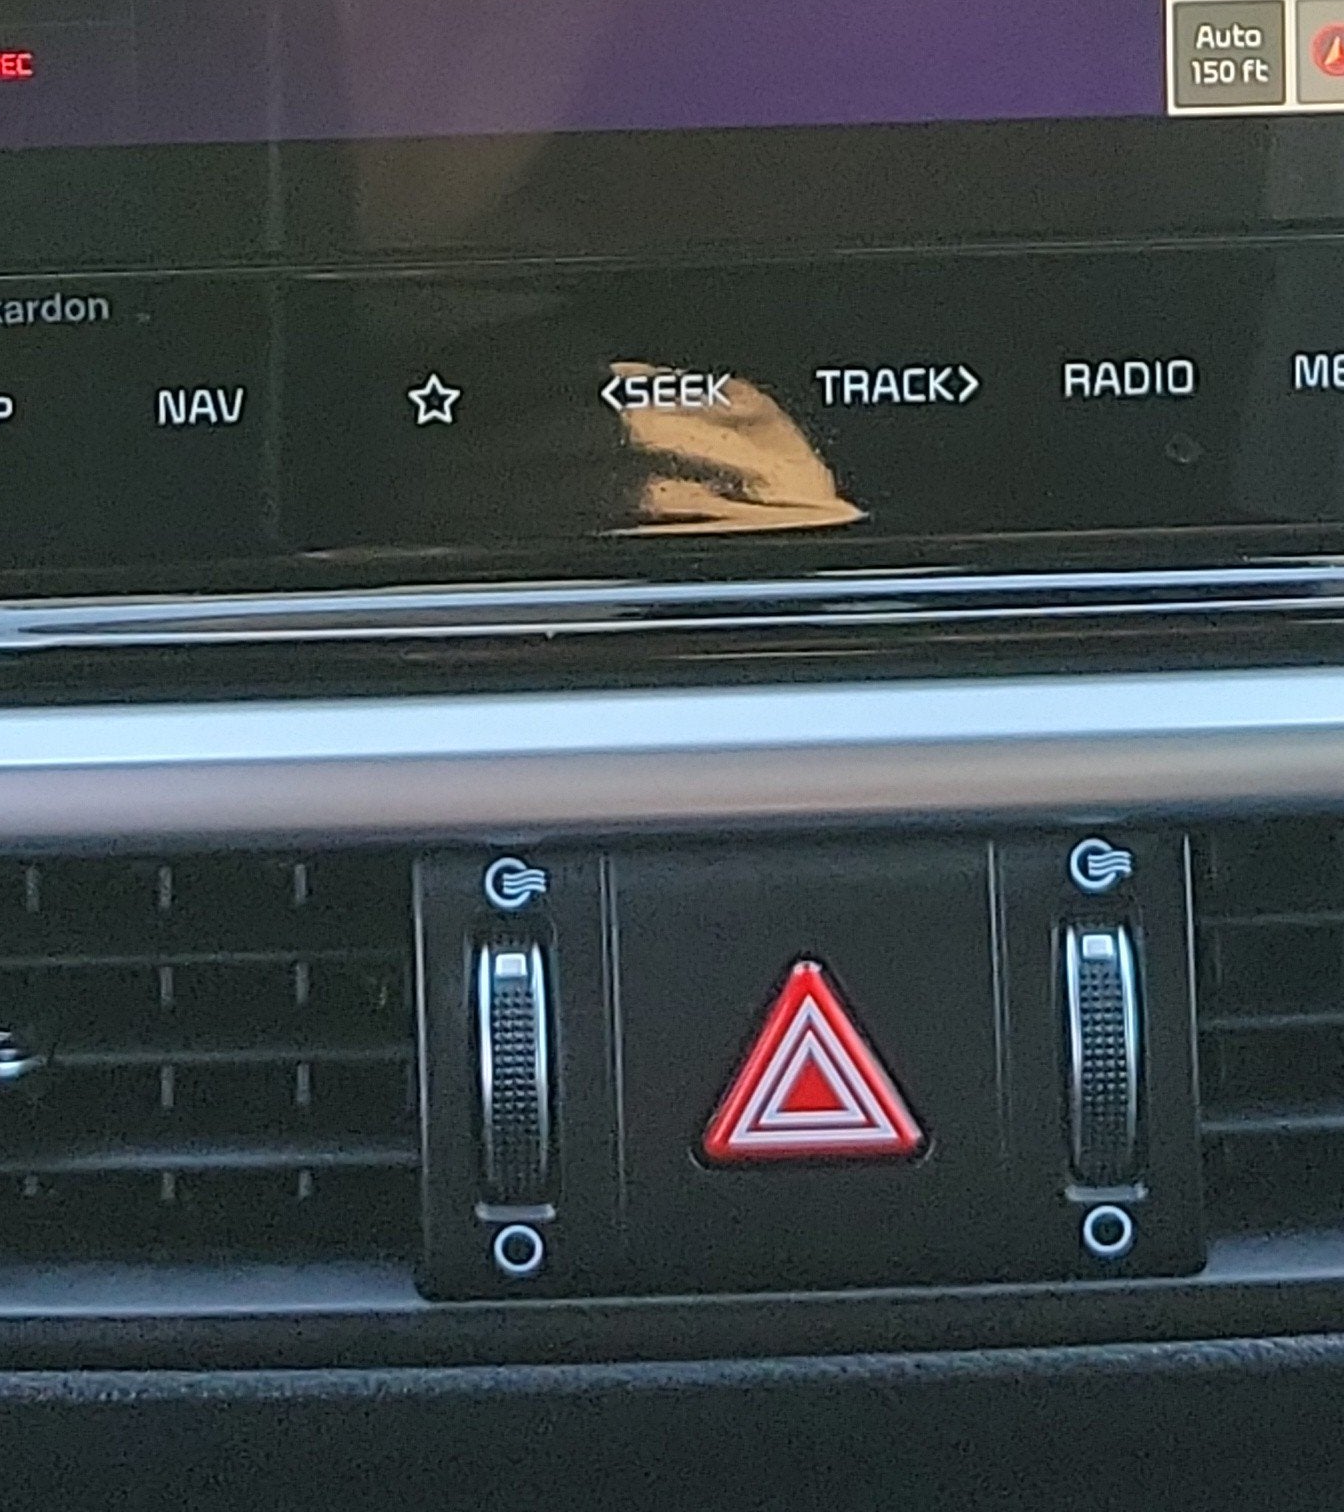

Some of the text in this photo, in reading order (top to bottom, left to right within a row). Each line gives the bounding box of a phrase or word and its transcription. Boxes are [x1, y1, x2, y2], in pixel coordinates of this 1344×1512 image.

[1196, 24, 1261, 49] Auto
[1192, 59, 1269, 84] 150 ft
[1064, 360, 1193, 397] RADIO
[159, 388, 243, 424] NAV
